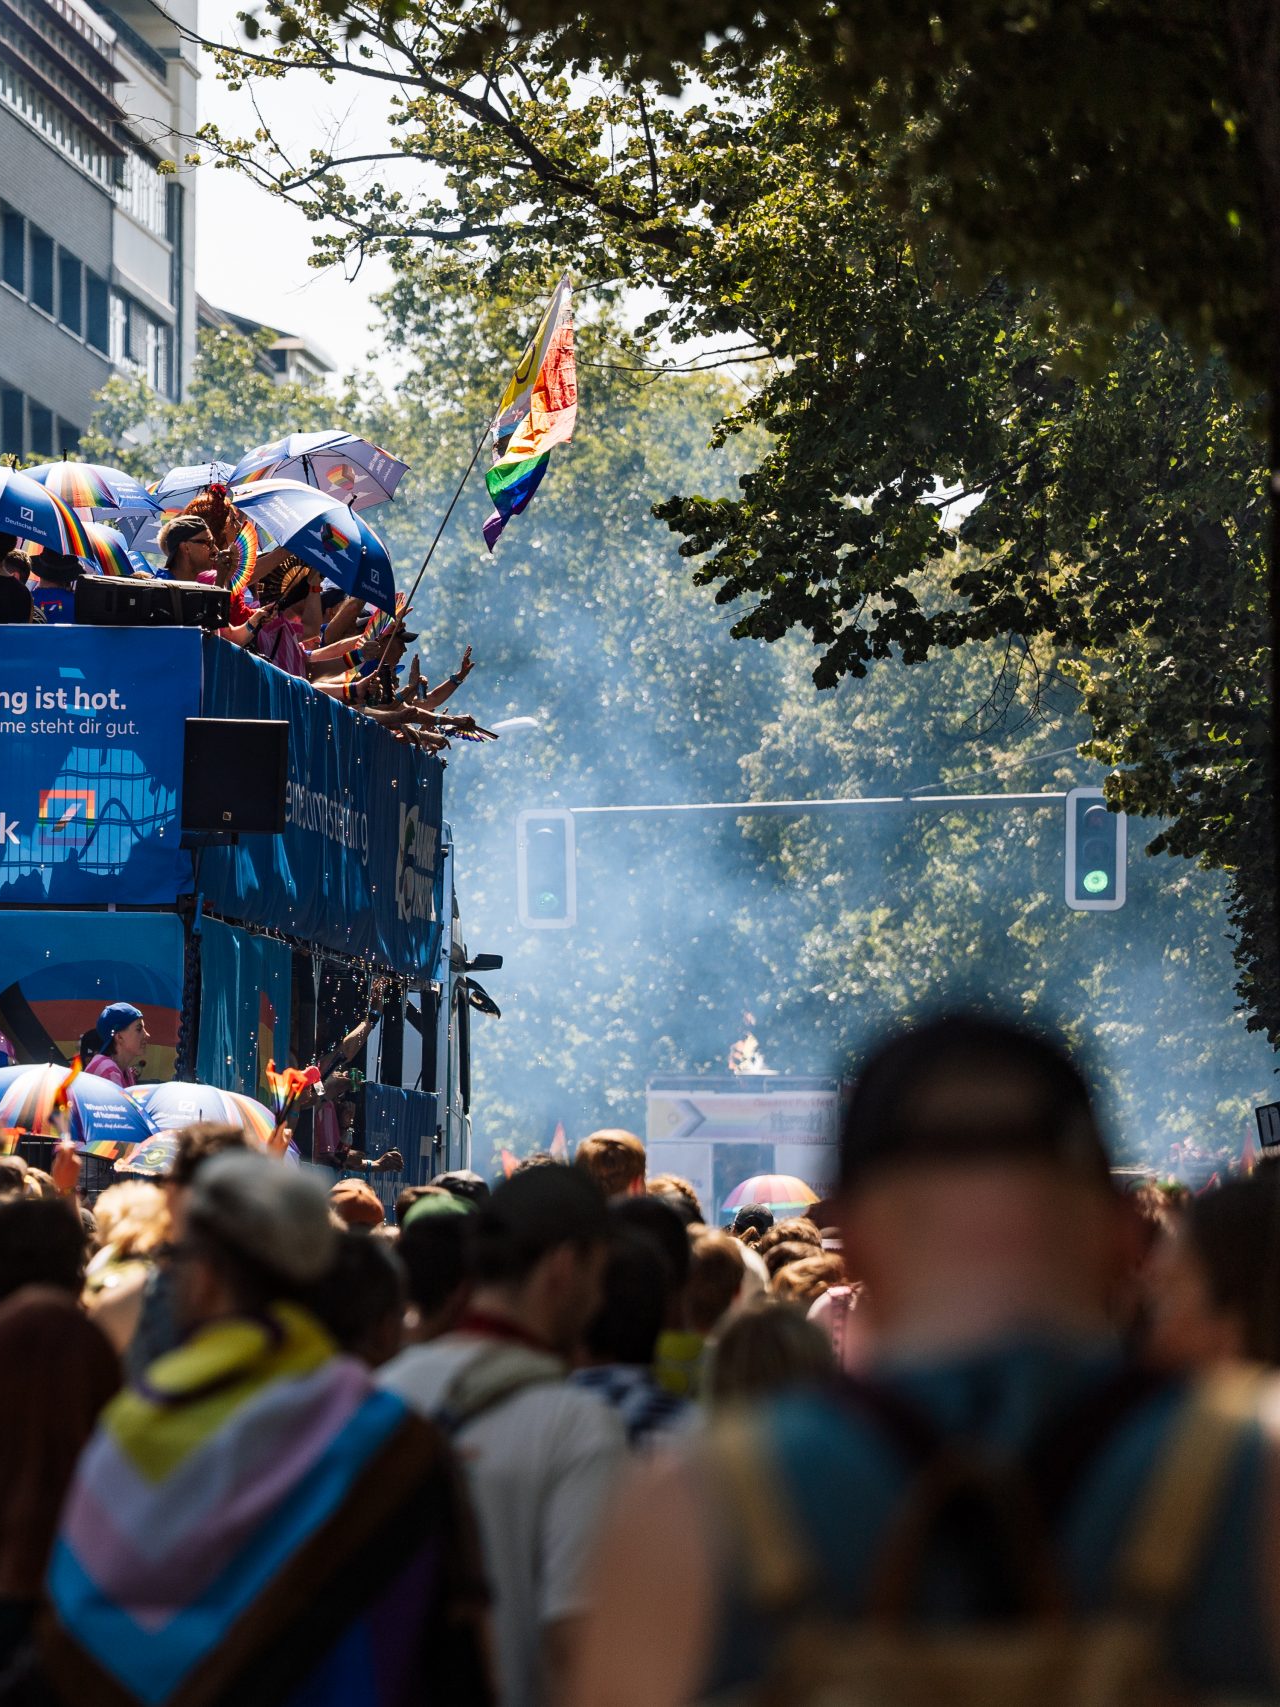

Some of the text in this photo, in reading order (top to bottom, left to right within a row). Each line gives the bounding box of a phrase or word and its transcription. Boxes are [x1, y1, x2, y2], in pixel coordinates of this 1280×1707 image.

[4, 516, 47, 537] Deutsche Bank
[35, 686, 67, 710] ist
[74, 686, 127, 710] hot.
[30, 718, 74, 735] steht
[79, 718, 102, 735] dir
[106, 720, 140, 739] gut.
[83, 1103, 104, 1111] When
[107, 1105, 128, 1113] think
